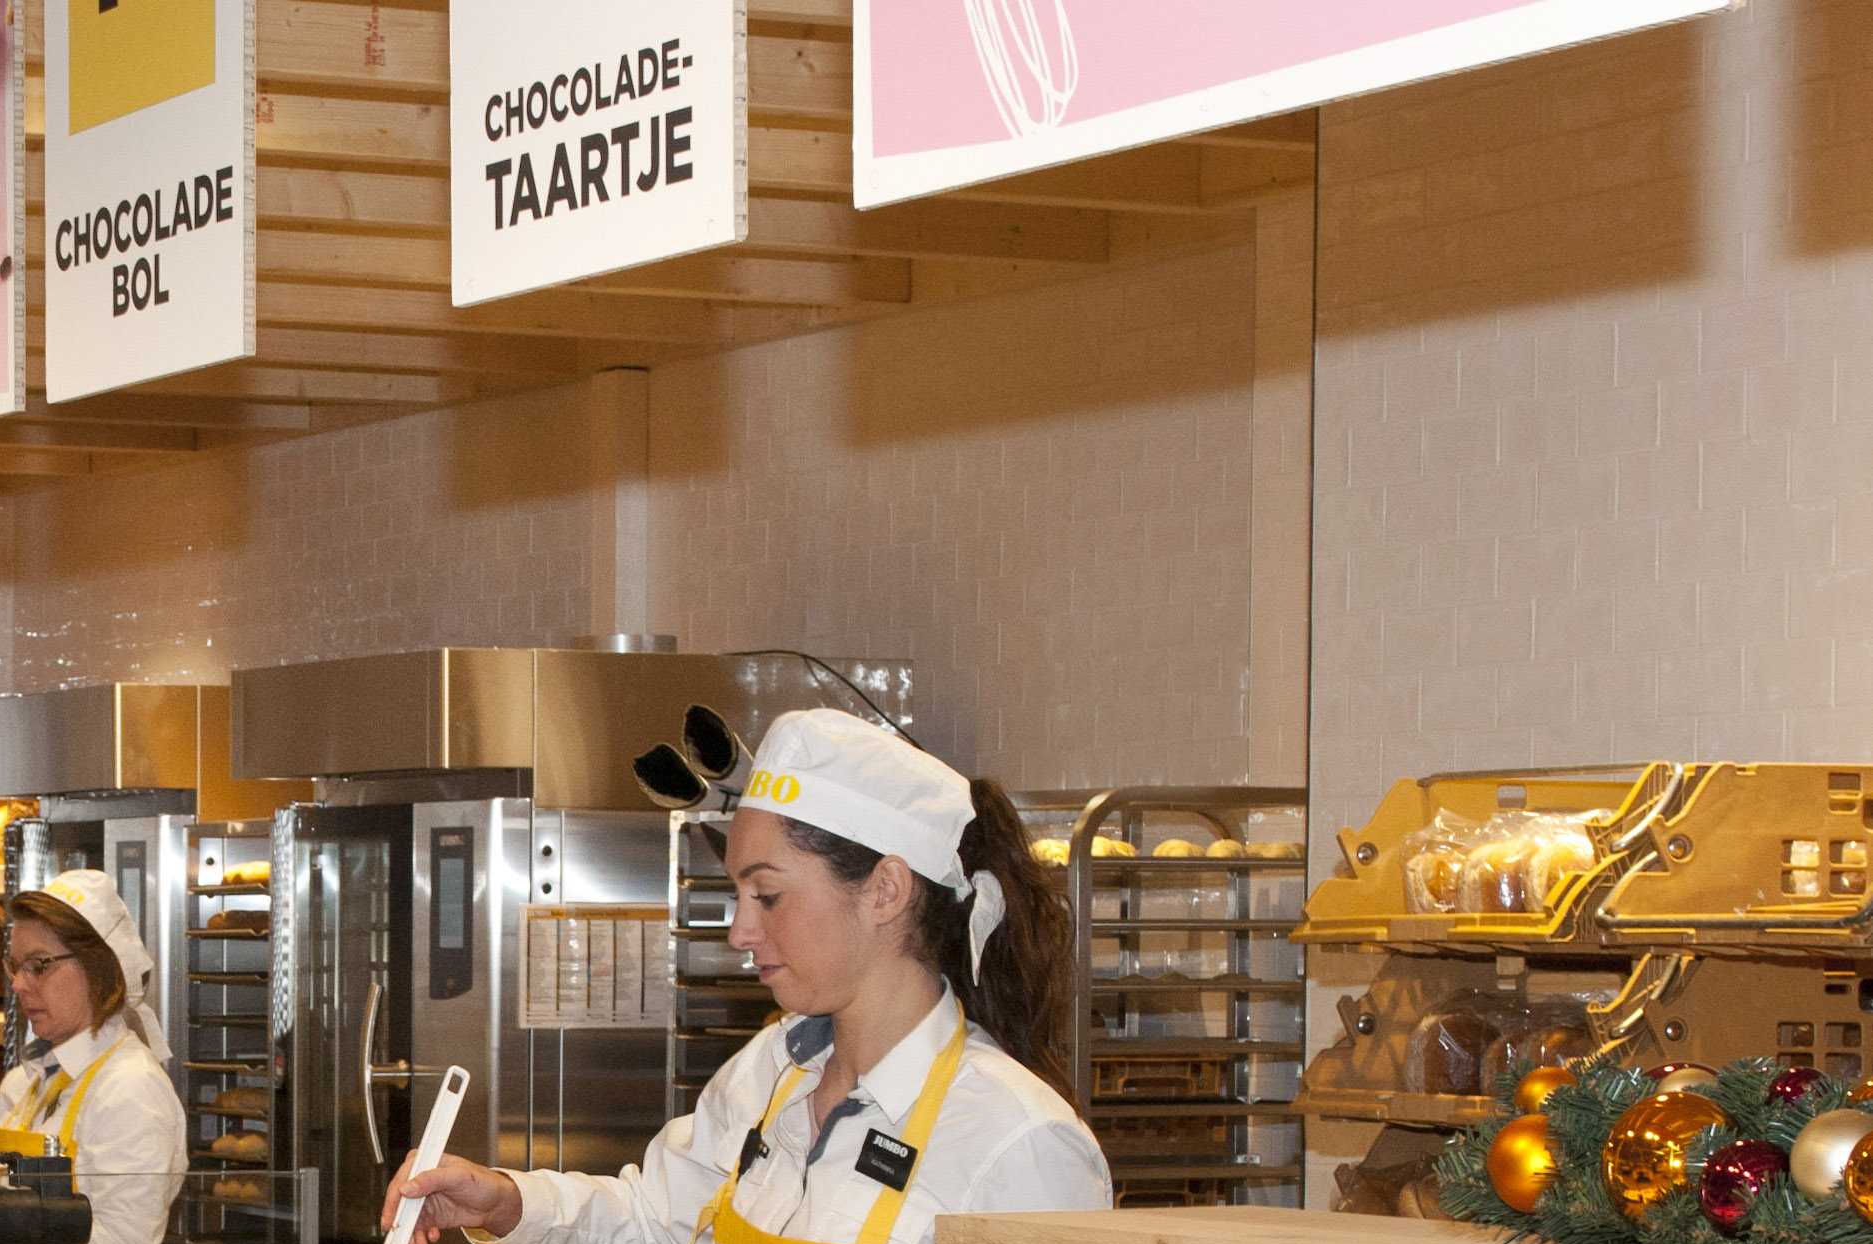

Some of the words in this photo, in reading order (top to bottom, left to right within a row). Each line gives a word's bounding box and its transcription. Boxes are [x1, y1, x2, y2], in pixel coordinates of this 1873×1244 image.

[485, 38, 693, 142] CHOCOLADE-
[55, 165, 233, 272] CHOCOLADE
[485, 106, 693, 231] TAARTJE
[113, 253, 170, 318] BOL
[873, 1134, 909, 1158] JUMBO
